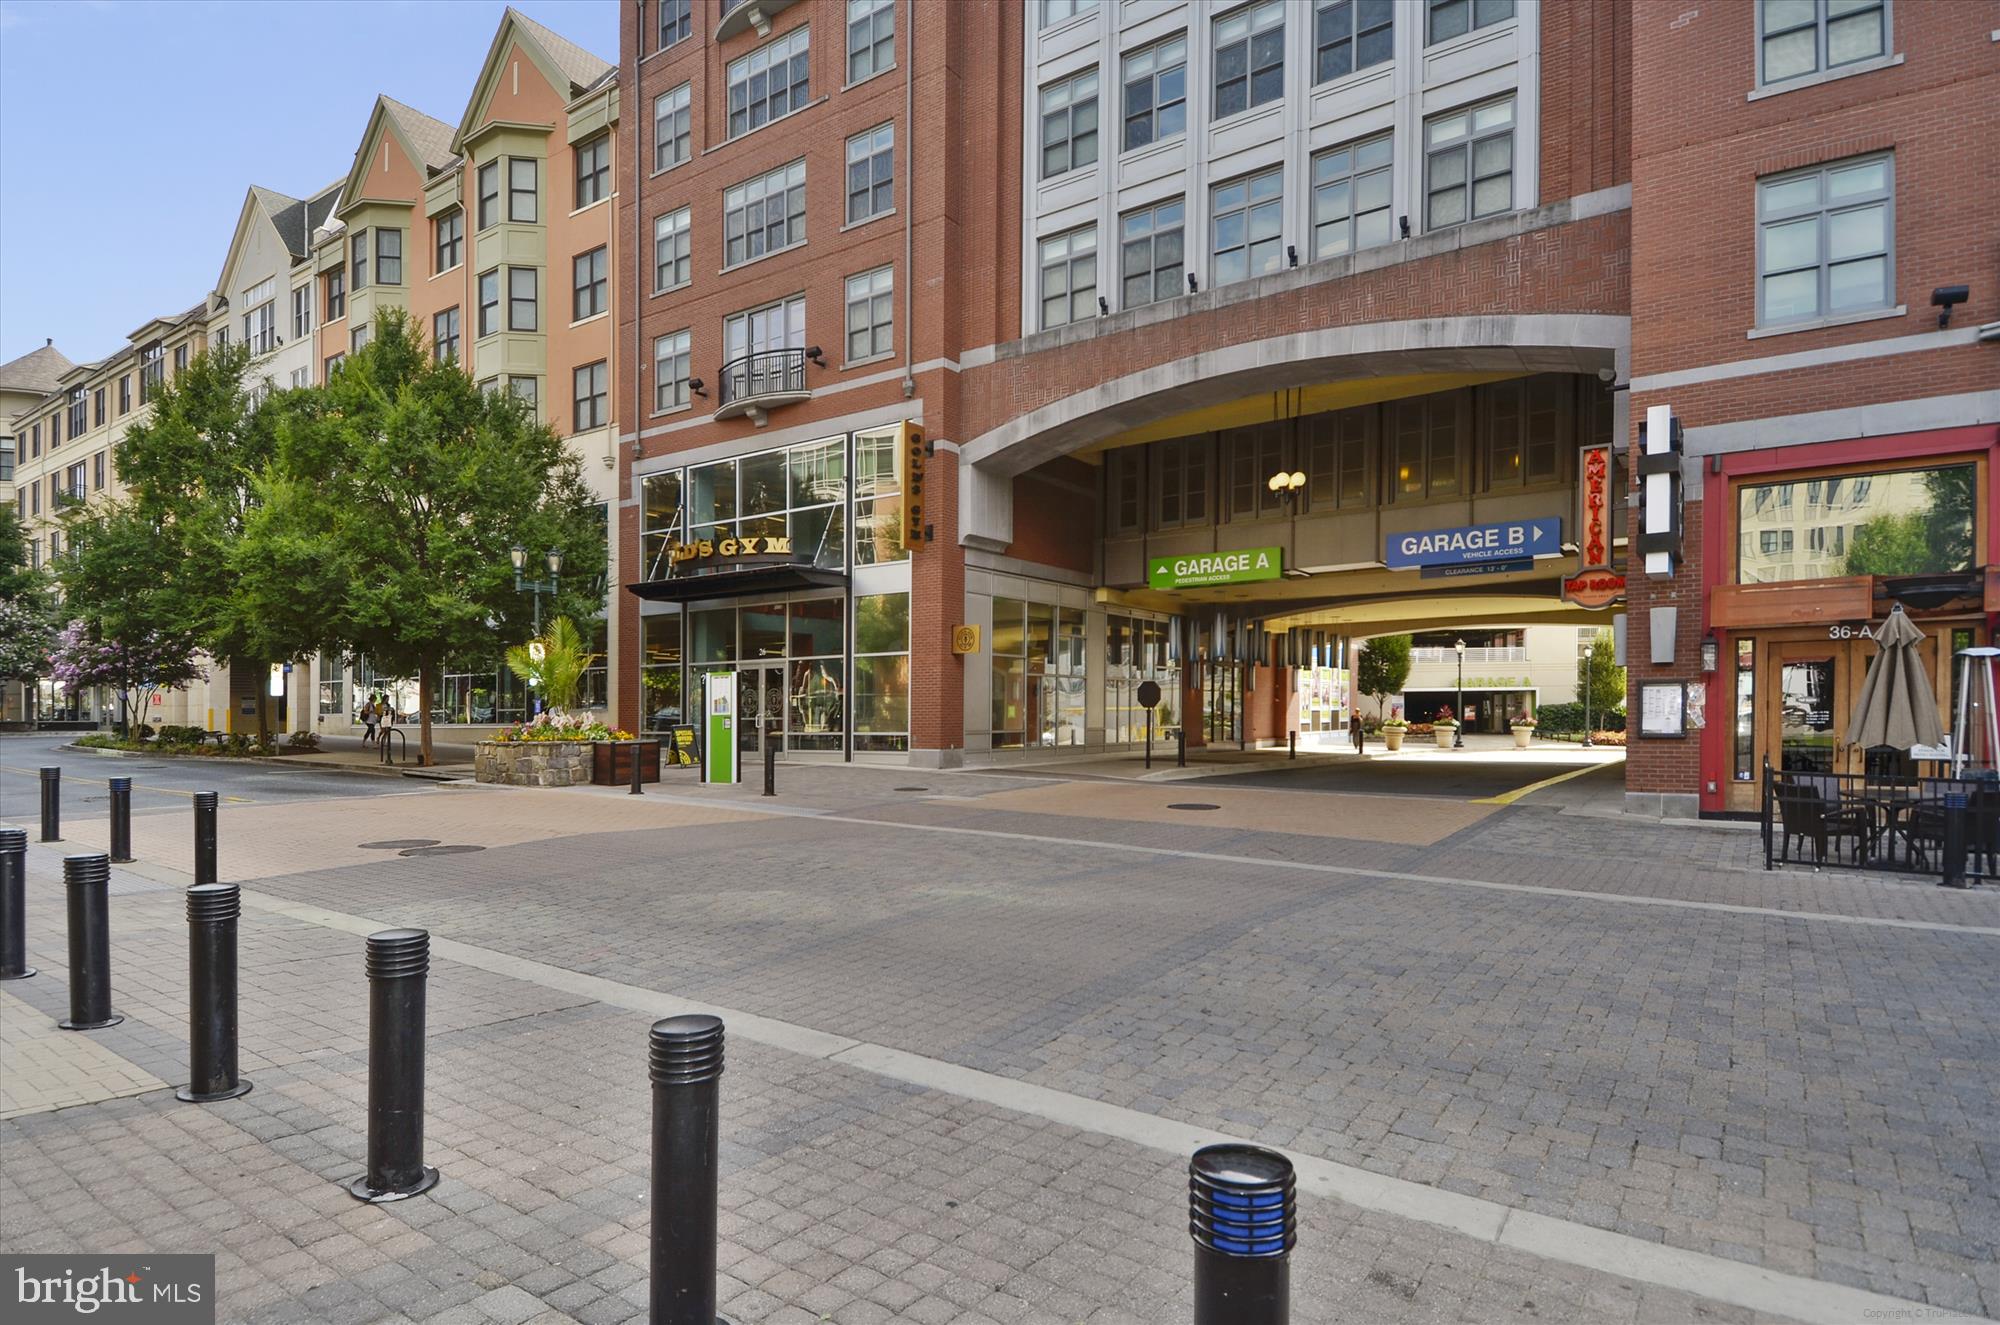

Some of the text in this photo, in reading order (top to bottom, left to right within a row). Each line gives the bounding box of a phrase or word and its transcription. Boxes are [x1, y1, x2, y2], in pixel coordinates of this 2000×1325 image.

[1587, 449, 1606, 565] AMERICAN
[718, 537, 793, 556] GYM
[1401, 526, 1525, 556] GARAGE B
[1462, 547, 1524, 560] VEHICLE ACCESS
[1174, 552, 1270, 576] GARAGE A
[1444, 567, 1484, 576] CLEARANCE
[1829, 625, 1873, 639] 36-A
